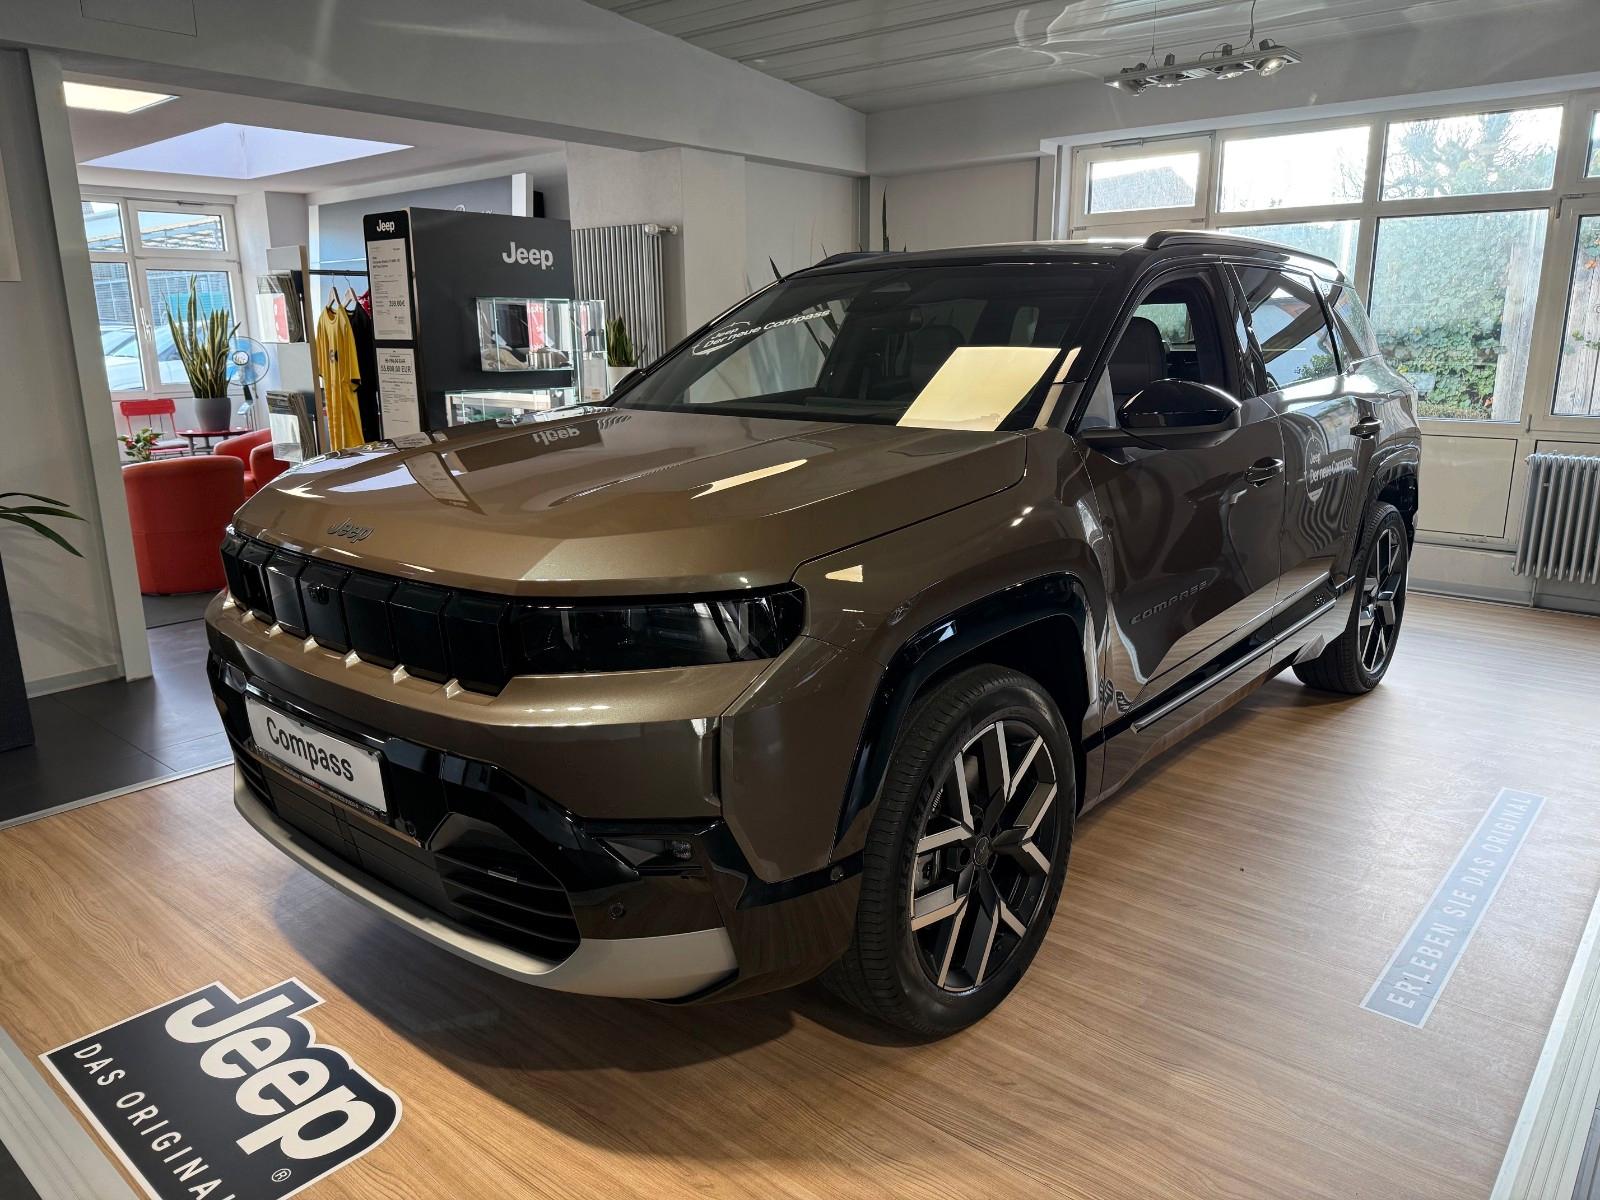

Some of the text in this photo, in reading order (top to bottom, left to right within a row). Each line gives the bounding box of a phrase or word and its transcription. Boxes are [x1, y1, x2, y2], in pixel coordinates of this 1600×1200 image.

[377, 219, 396, 233] Jeep
[502, 241, 554, 270] Jeep
[703, 309, 831, 349] Der neue Compass
[711, 327, 739, 340] Jeep
[327, 517, 375, 544] Jeep
[266, 716, 354, 782] Compass
[1386, 798, 1532, 1009] ERLEBEN SIE DAS ORIGINAL
[73, 1042, 126, 1087] DAS
[165, 993, 376, 1160] Jeep
